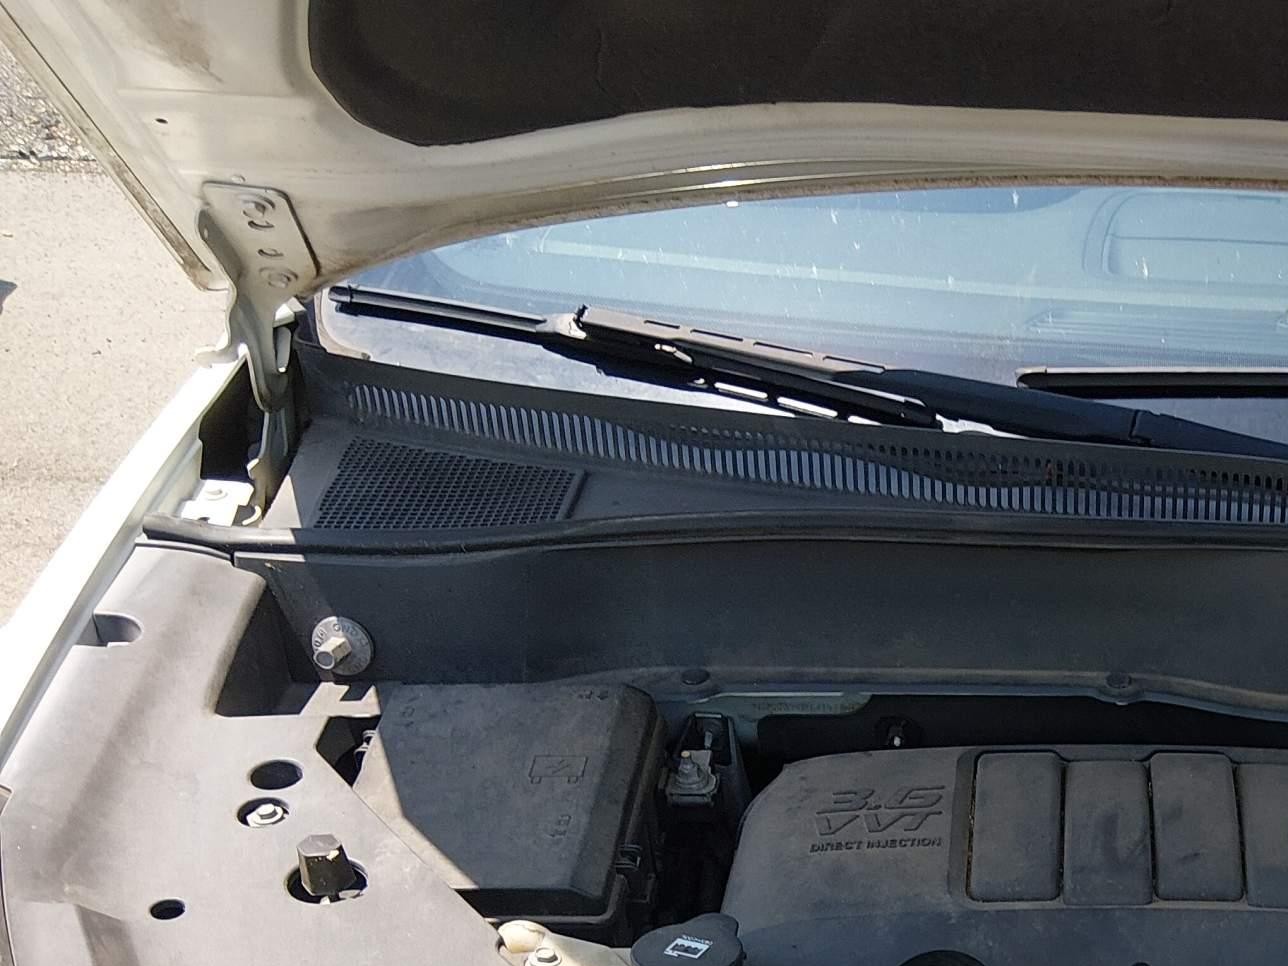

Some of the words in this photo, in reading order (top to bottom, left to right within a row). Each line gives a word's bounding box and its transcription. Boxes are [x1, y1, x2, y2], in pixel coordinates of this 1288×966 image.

[816, 786, 946, 814] 3.6
[815, 810, 943, 836] VVT
[809, 840, 863, 853] DIRECT
[866, 836, 942, 850] INJECTION
